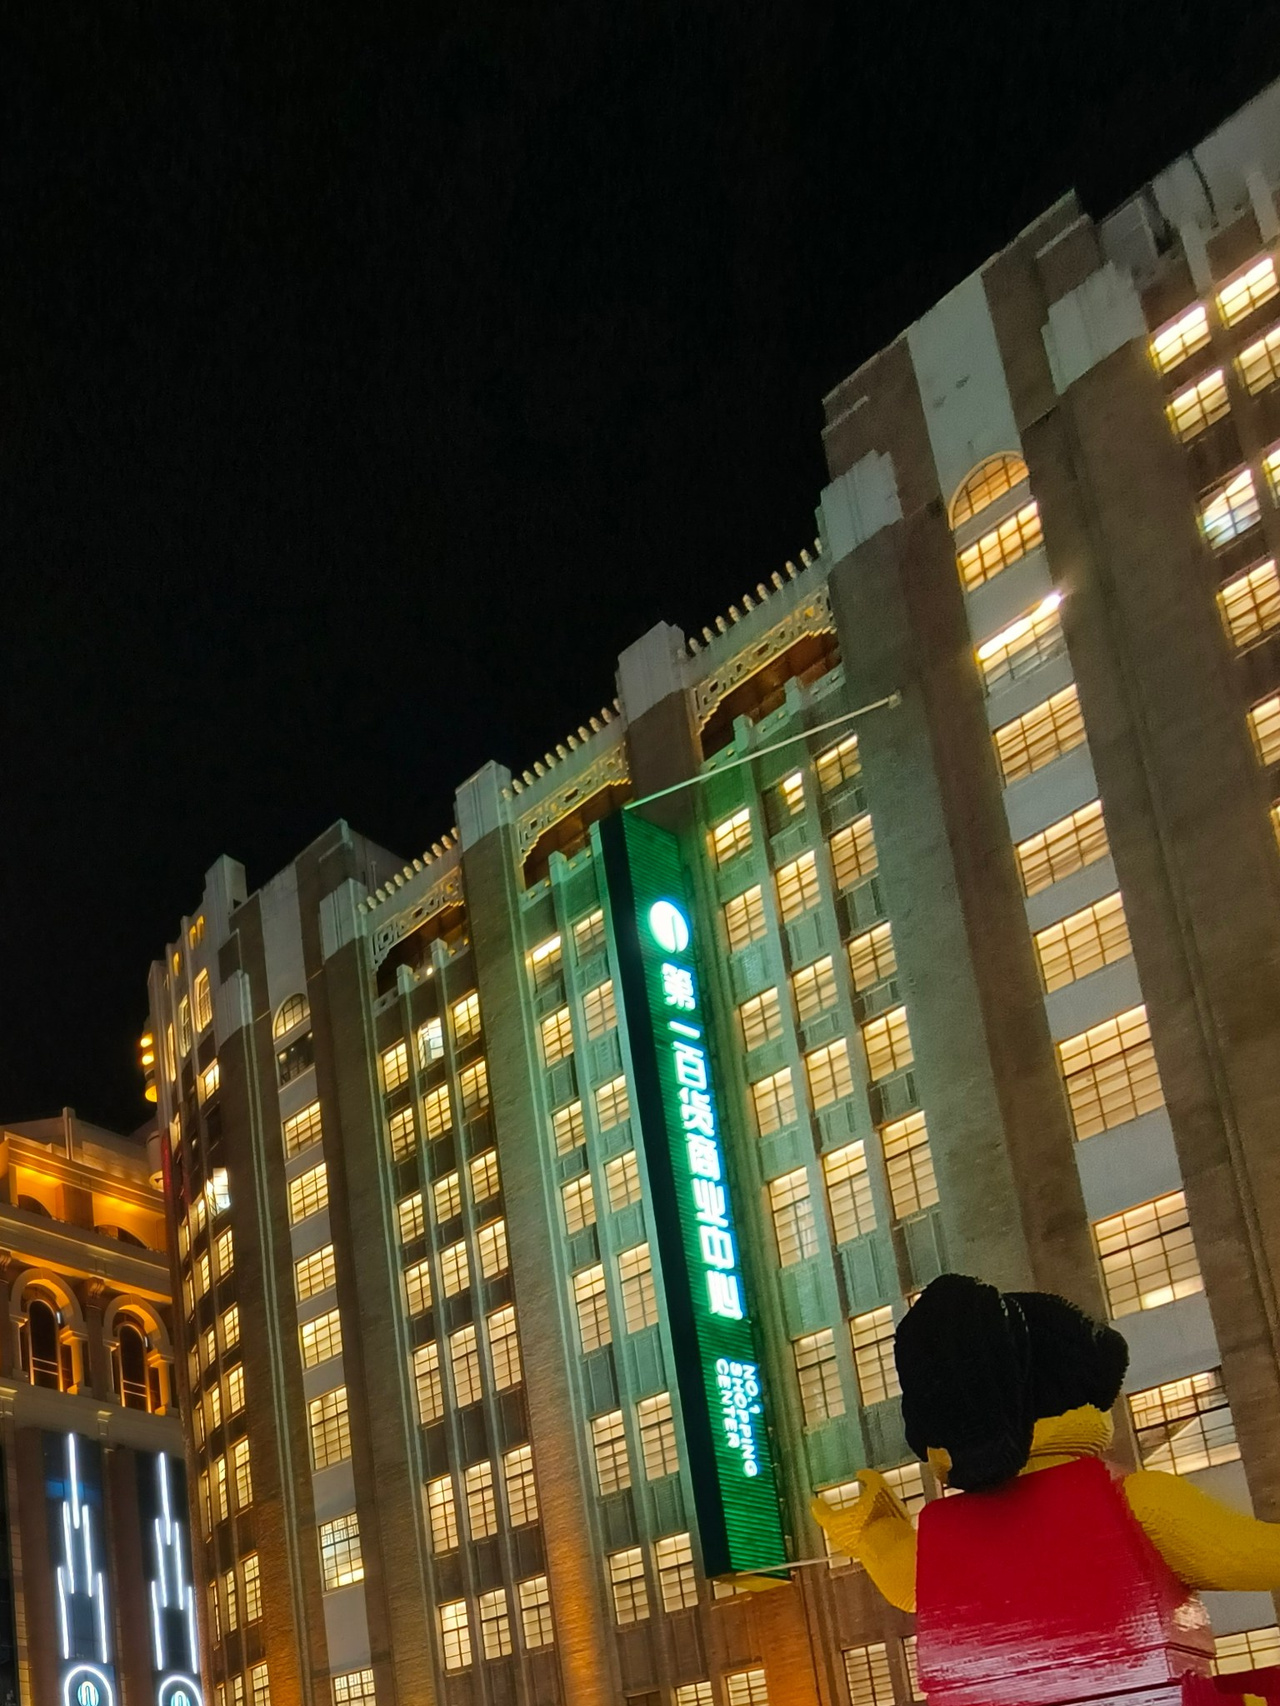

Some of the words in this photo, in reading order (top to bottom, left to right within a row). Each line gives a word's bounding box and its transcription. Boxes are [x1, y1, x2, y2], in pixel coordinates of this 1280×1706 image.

[661, 962, 743, 1320] 第一百货商业中心
[715, 1358, 740, 1449] CENTER
[729, 1361, 758, 1477] SHOPPING
[742, 1364, 760, 1414] NO.1
